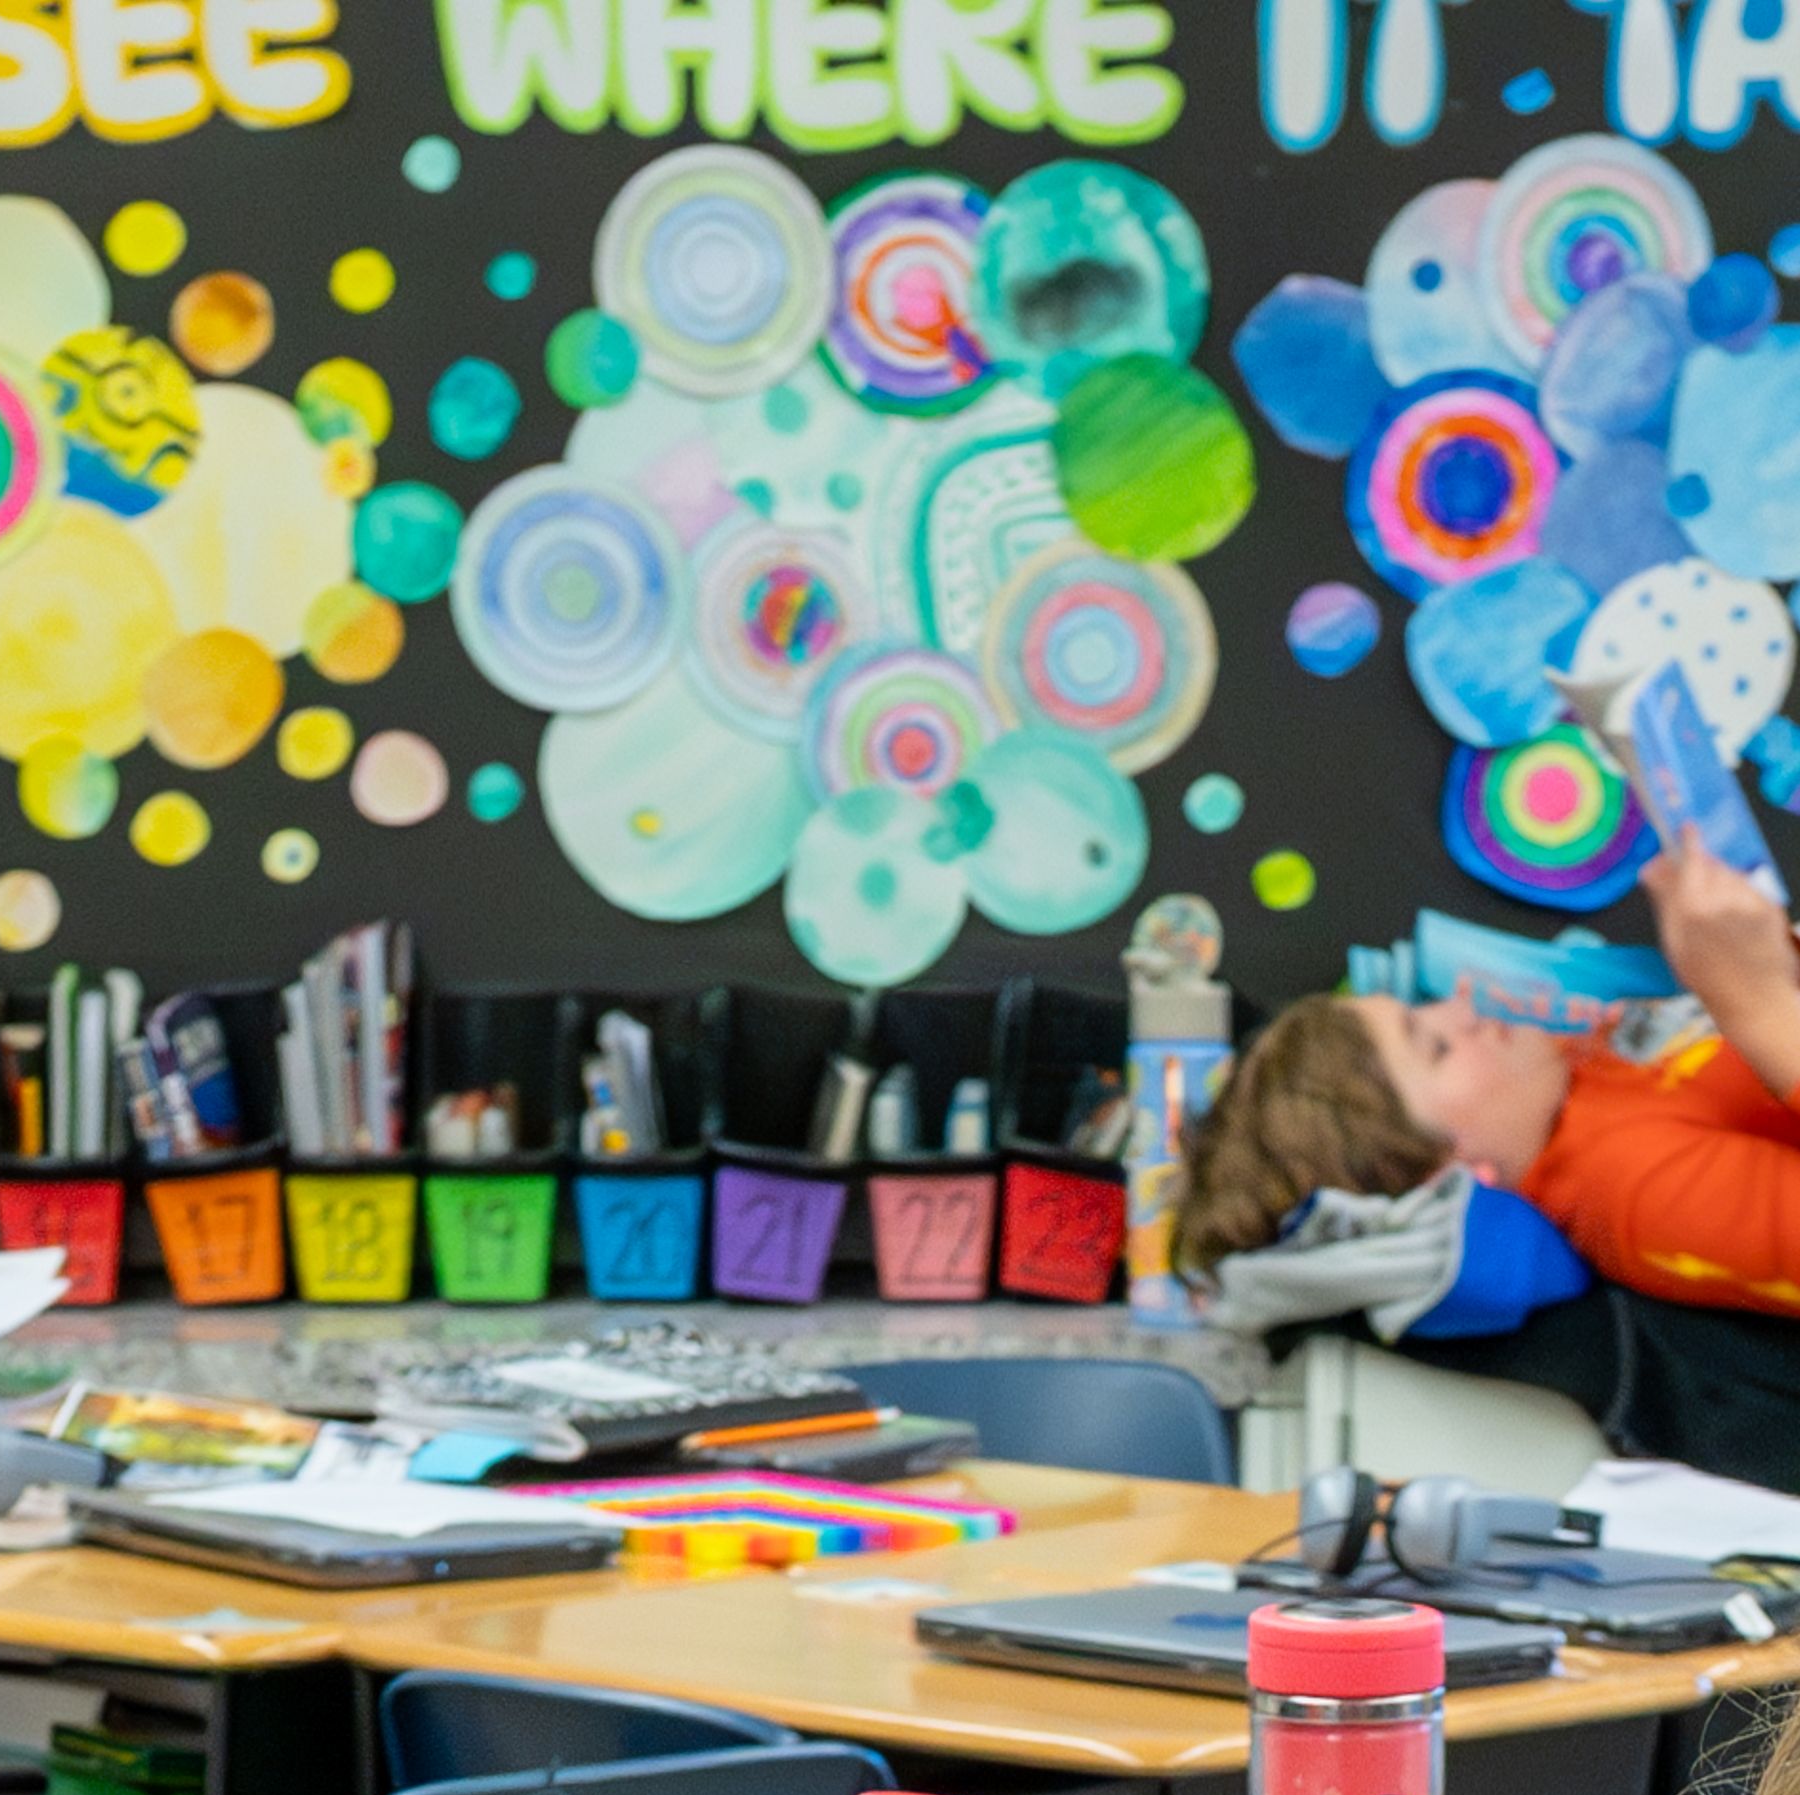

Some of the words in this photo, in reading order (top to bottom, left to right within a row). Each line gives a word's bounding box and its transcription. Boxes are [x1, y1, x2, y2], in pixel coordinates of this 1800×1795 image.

[436, 0, 1184, 152] WHERE
[186, 1196, 255, 1282] 17
[320, 1200, 386, 1282] 18
[461, 1200, 518, 1282] 19
[603, 1199, 685, 1287] 20
[731, 1192, 802, 1284] 21
[893, 1190, 973, 1286] 22
